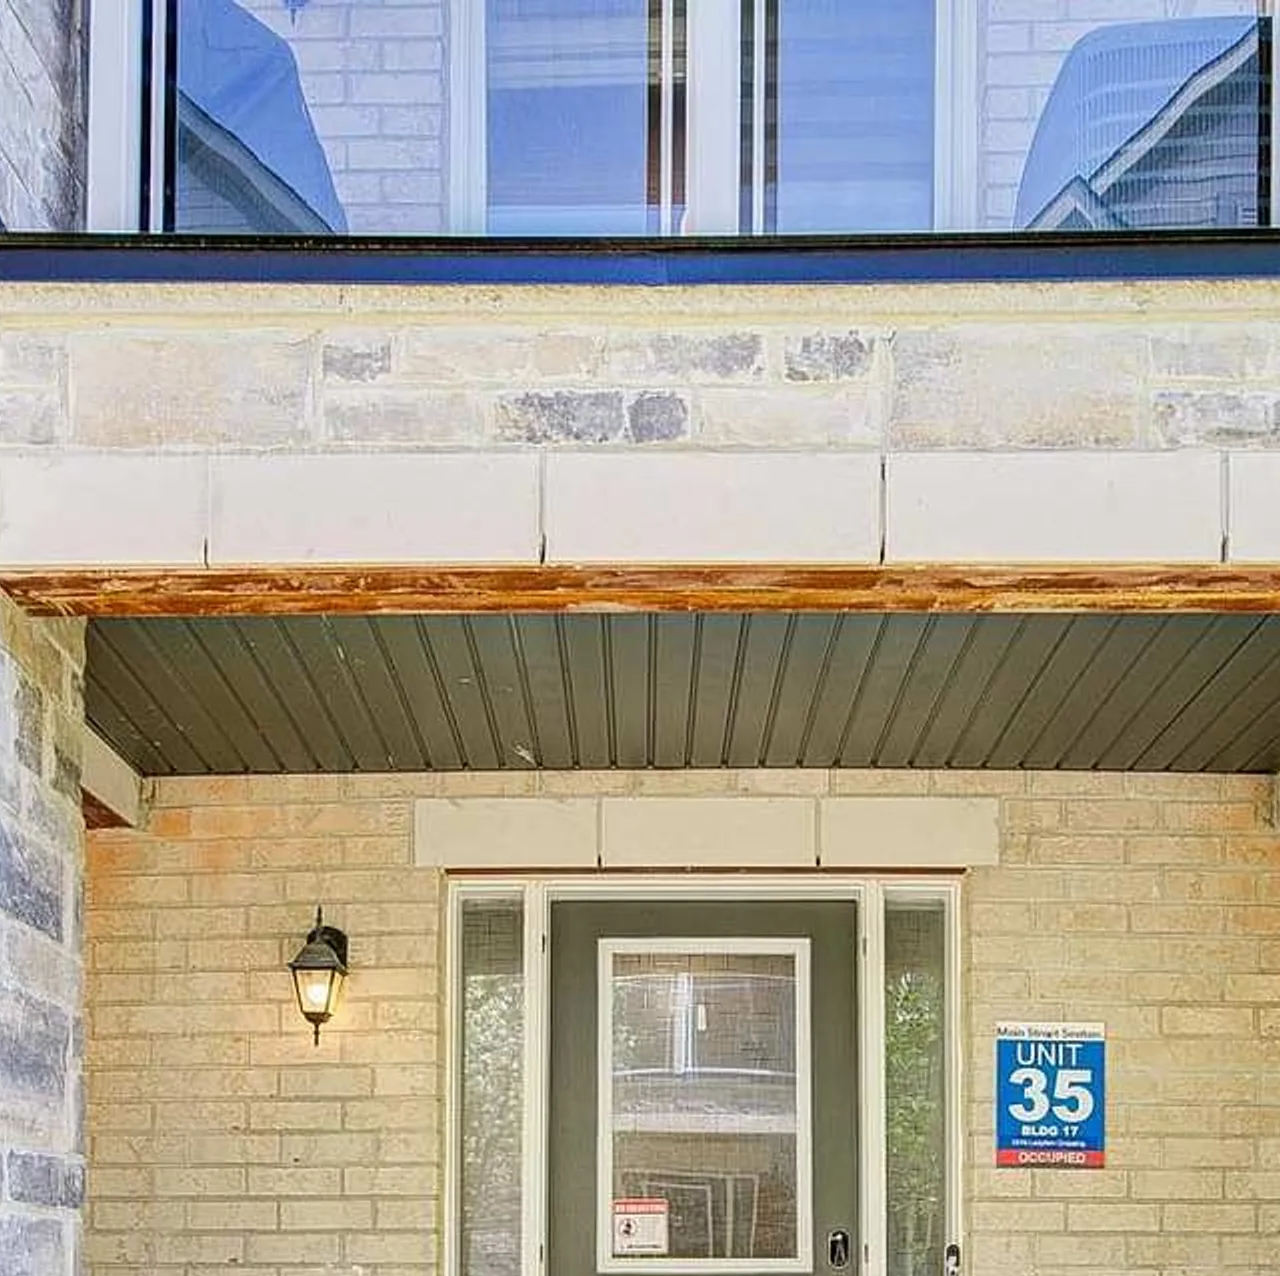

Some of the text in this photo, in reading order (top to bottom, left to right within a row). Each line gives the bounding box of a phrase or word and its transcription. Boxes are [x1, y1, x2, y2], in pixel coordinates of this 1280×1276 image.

[1017, 1042, 1083, 1066] UNIT
[1008, 1067, 1094, 1123] 35
[1021, 1125, 1079, 1137] BLDG 17
[1018, 1151, 1087, 1164] OCCUPIED
